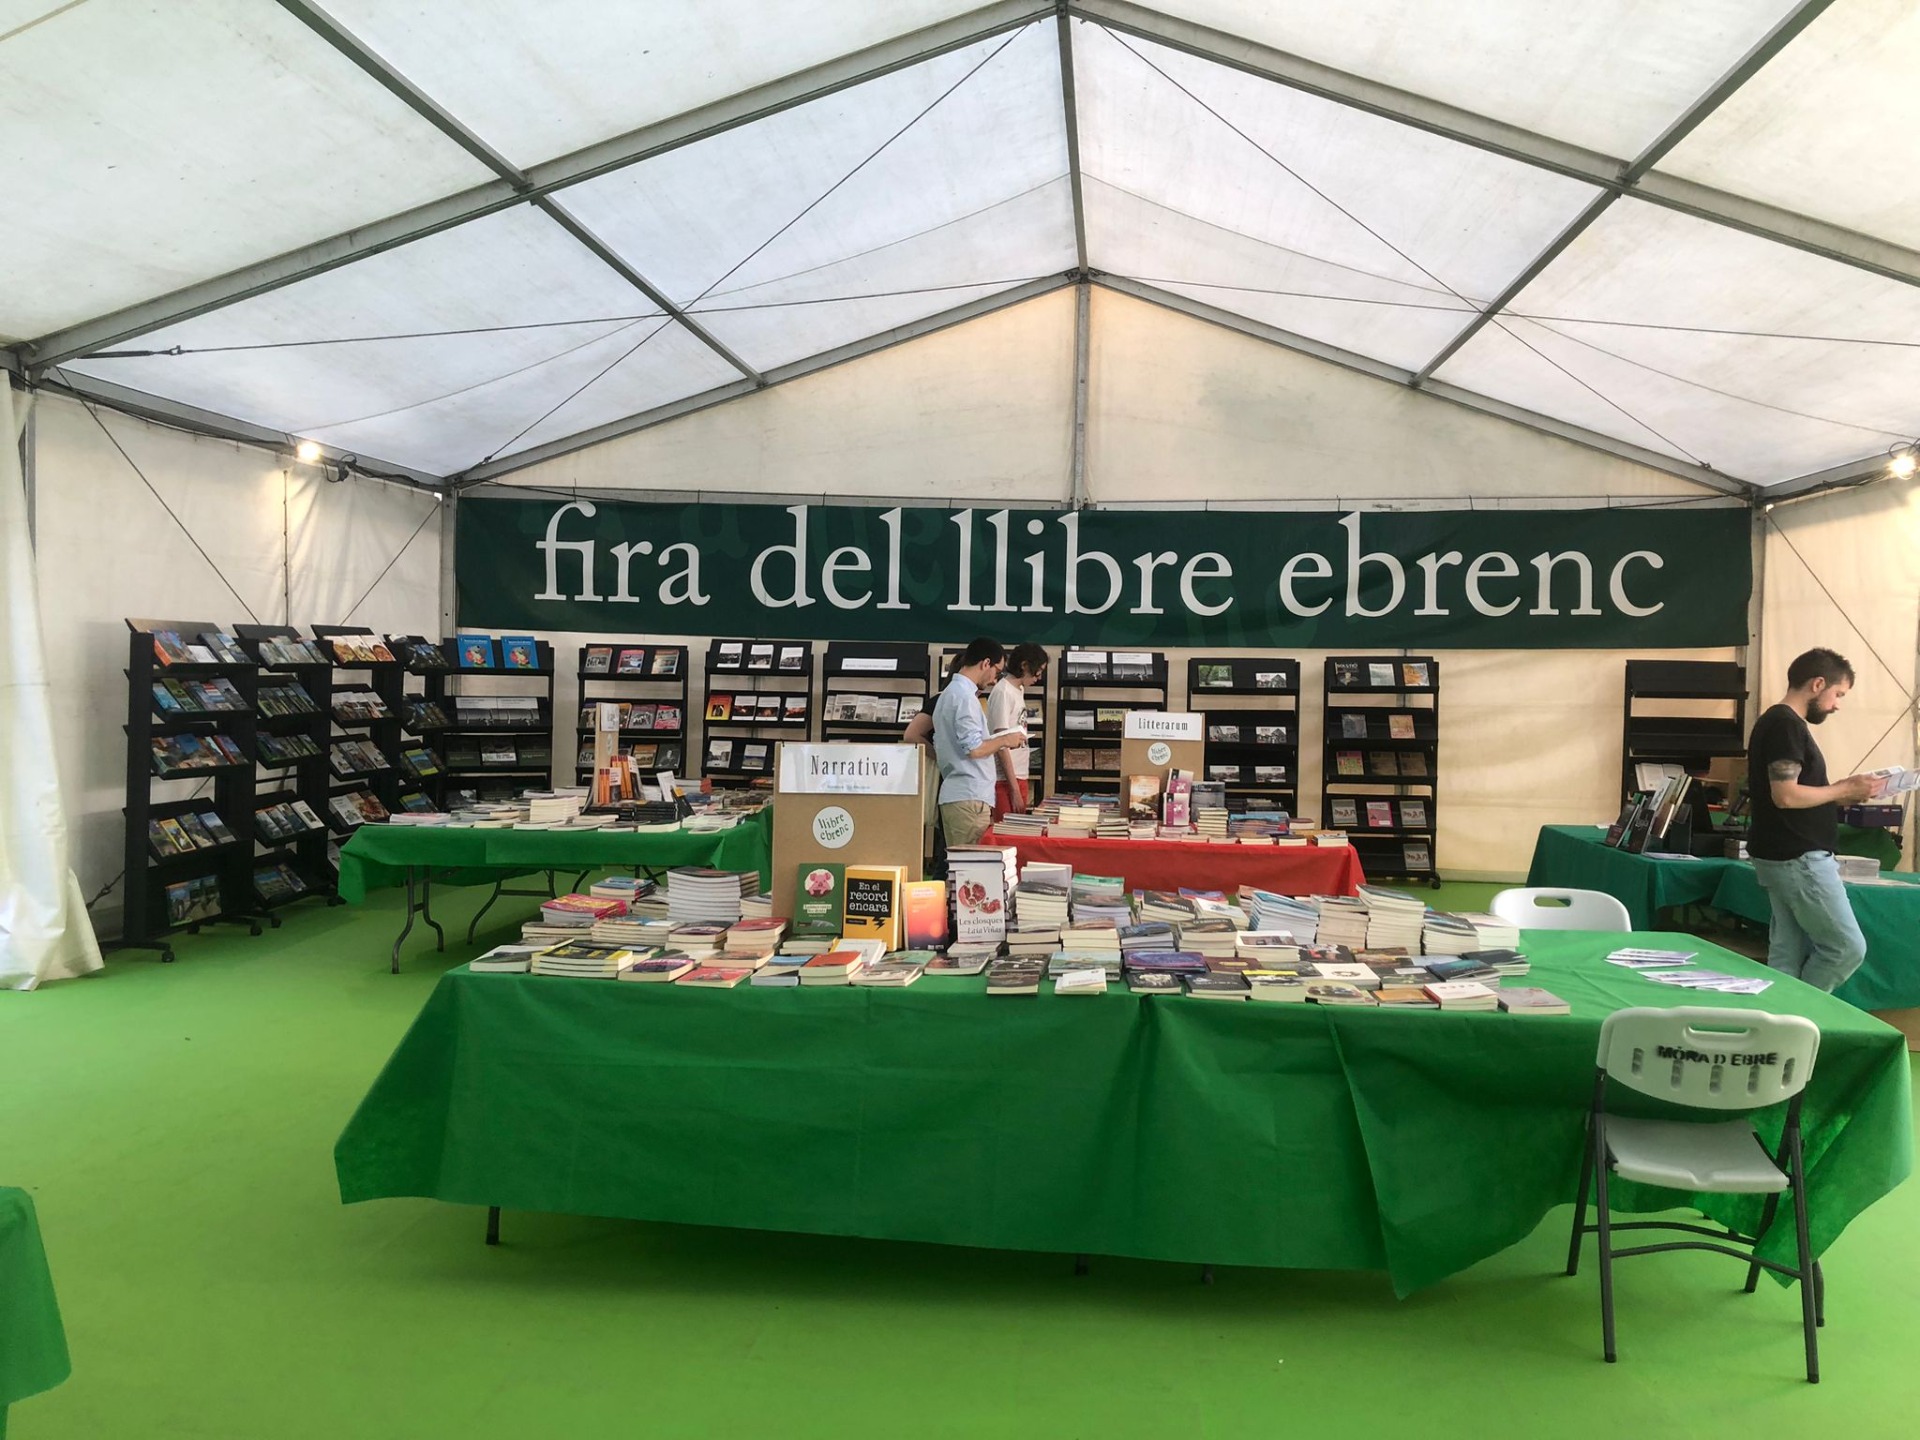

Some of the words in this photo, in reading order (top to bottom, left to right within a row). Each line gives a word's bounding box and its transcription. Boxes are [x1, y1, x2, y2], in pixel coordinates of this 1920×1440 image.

[535, 502, 711, 607] fira
[750, 505, 911, 611] del
[947, 508, 1235, 617] llibre
[1279, 511, 1665, 618] ebrenc
[811, 755, 889, 776] Narrativa
[818, 814, 845, 829] llibre
[820, 824, 849, 840] ebrenc
[858, 882, 870, 891] En
[872, 883, 880, 892] el
[850, 891, 889, 902] record
[849, 902, 889, 913] encara
[972, 916, 1003, 925] closques
[1730, 1052, 1778, 1066] EBRE
